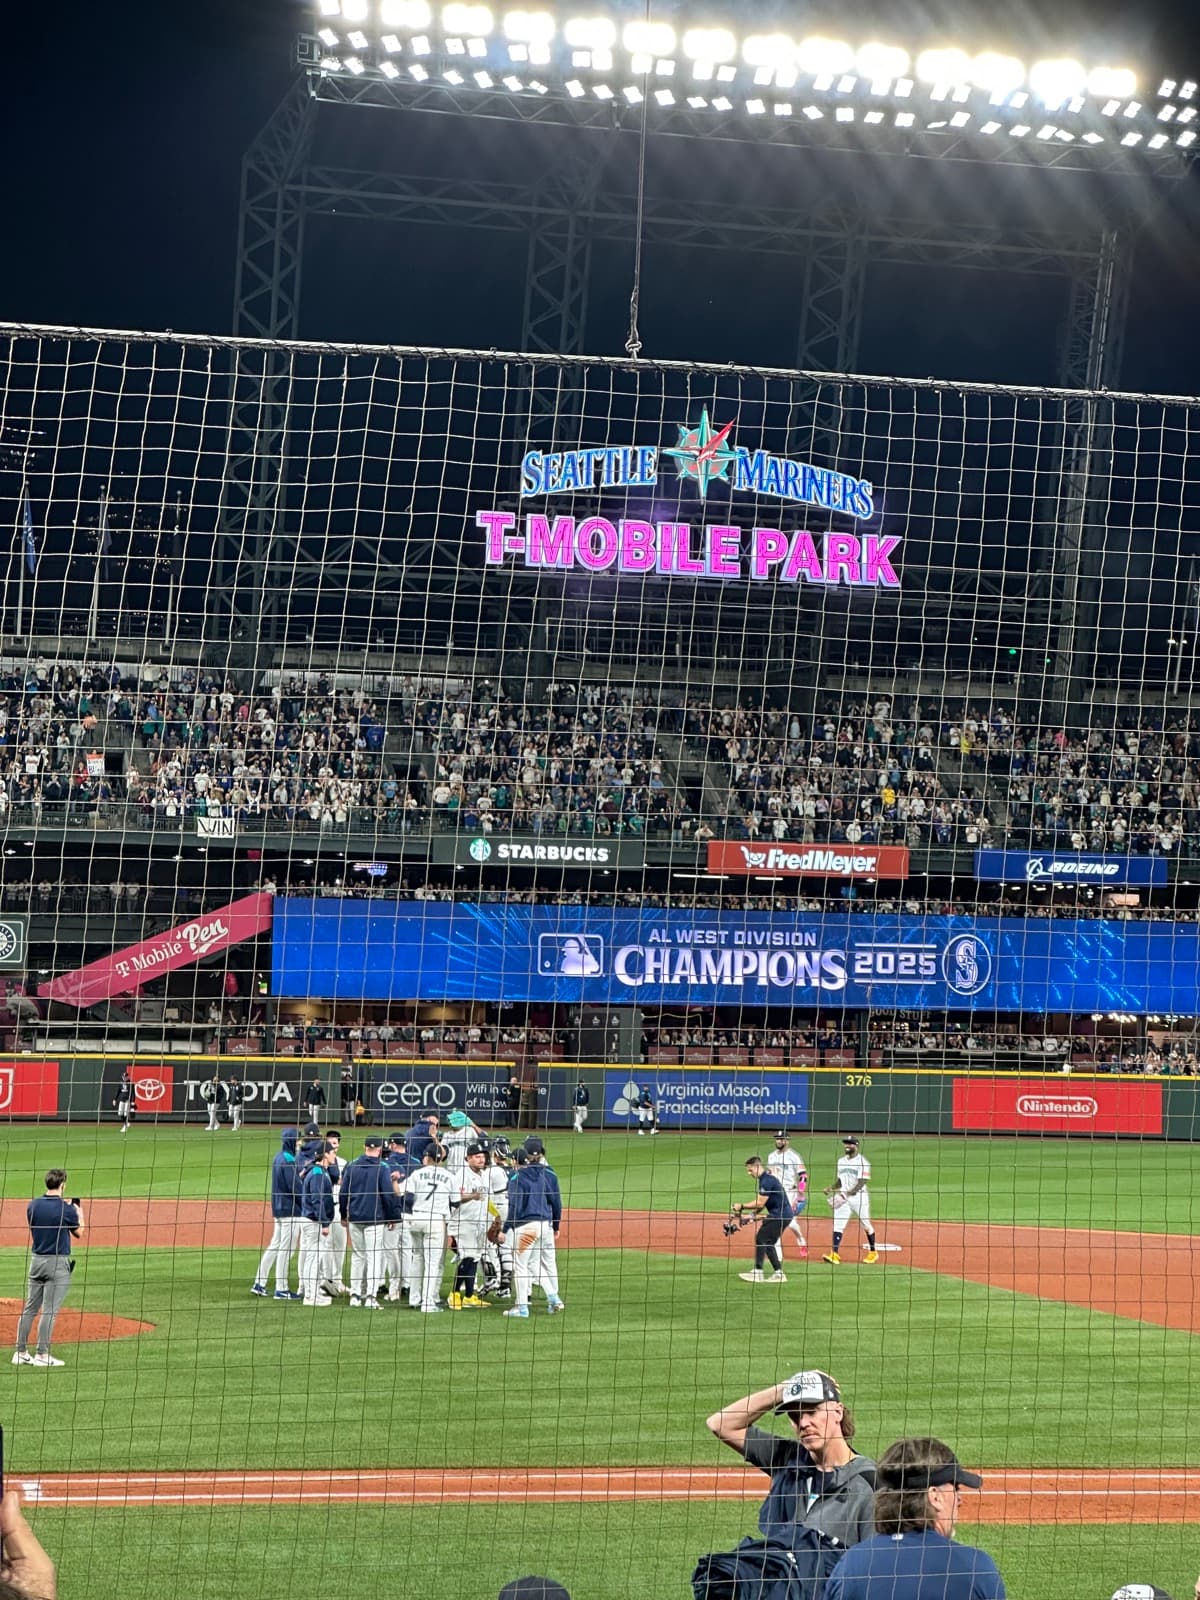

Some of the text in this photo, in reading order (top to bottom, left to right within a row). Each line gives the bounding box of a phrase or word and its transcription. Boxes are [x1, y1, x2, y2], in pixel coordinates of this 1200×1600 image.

[521, 446, 874, 520] SEATTLE MARINERS
[476, 510, 902, 587] T-MOBILE PARK
[497, 843, 609, 861] STARBUCKS
[1048, 862, 1119, 875] BOEING
[649, 928, 817, 946] AL WEST DIVISION
[130, 942, 183, 971] Mobile
[855, 951, 937, 976] 2025
[614, 944, 848, 990] CHAMPIONS
[466, 1084, 487, 1094] Wifi
[489, 1084, 499, 1095] in
[846, 1075, 872, 1087] 376
[377, 1082, 456, 1107] eero
[656, 1082, 770, 1099] Virginia Mason
[466, 1099, 477, 1108] of
[479, 1099, 490, 1108] its
[656, 1100, 796, 1115] Franciscan Health
[1023, 1100, 1090, 1112] Nintendo
[427, 1183, 438, 1201] 7
